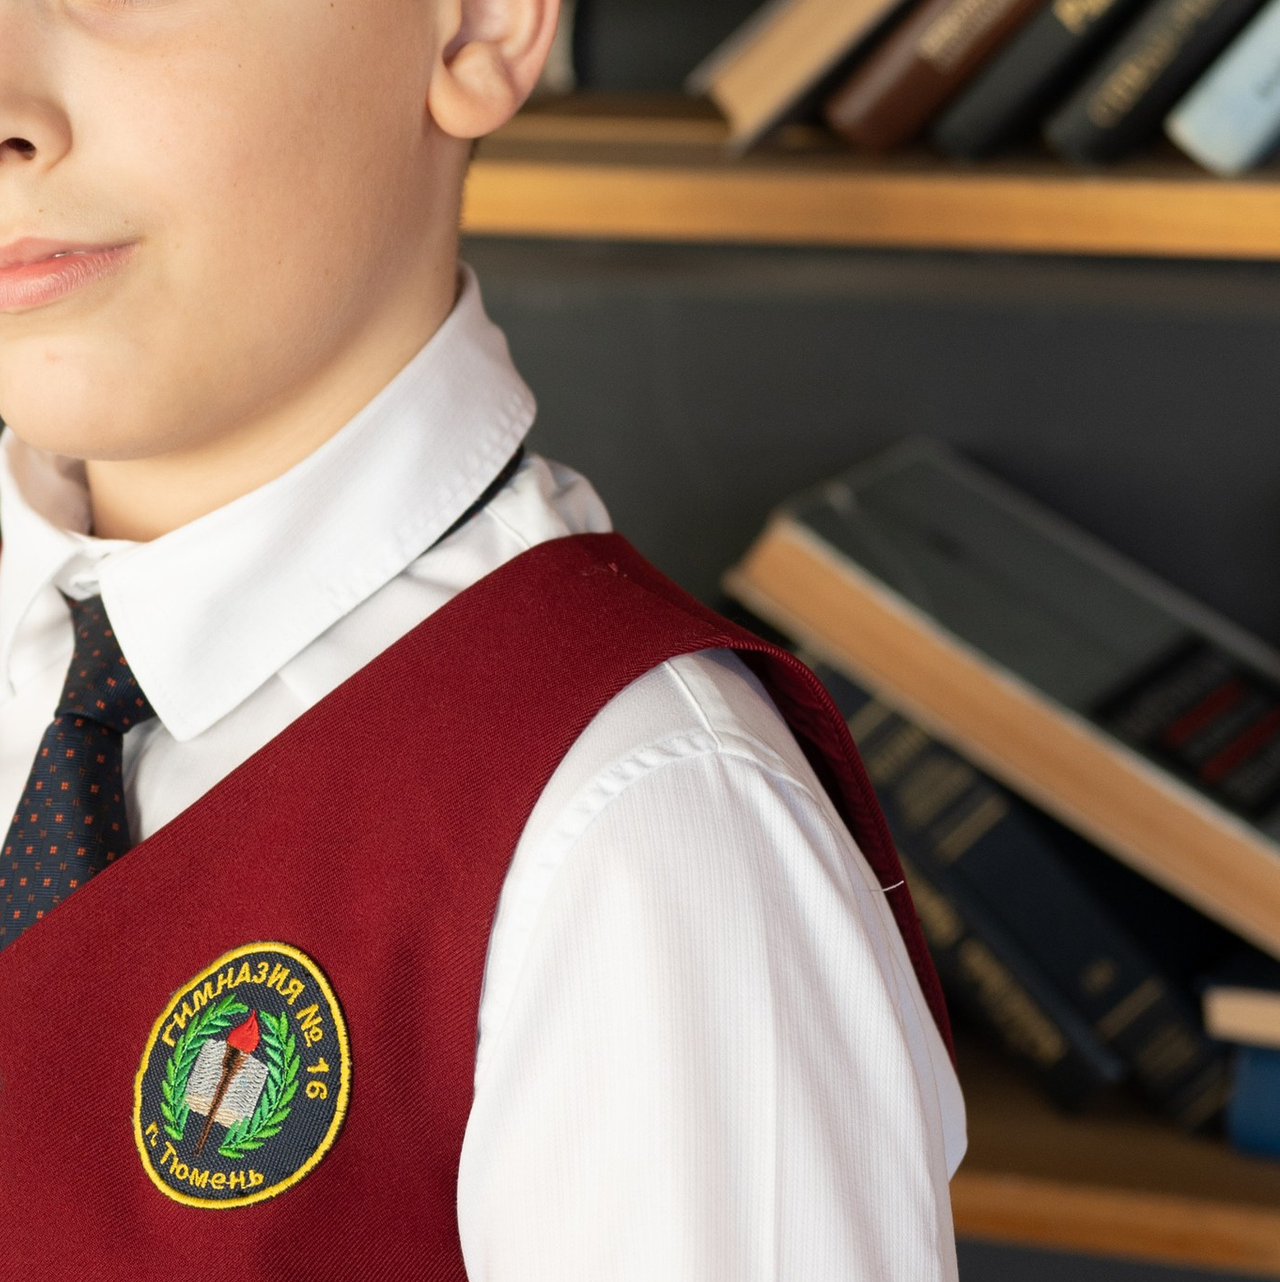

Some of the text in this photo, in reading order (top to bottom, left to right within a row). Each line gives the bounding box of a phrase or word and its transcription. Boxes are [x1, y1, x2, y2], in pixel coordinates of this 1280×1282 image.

[161, 961, 305, 1047] ГИМНАЗИЯ
[305, 1057, 330, 1100] 16
[145, 1120, 264, 1190] г. Тюмень
